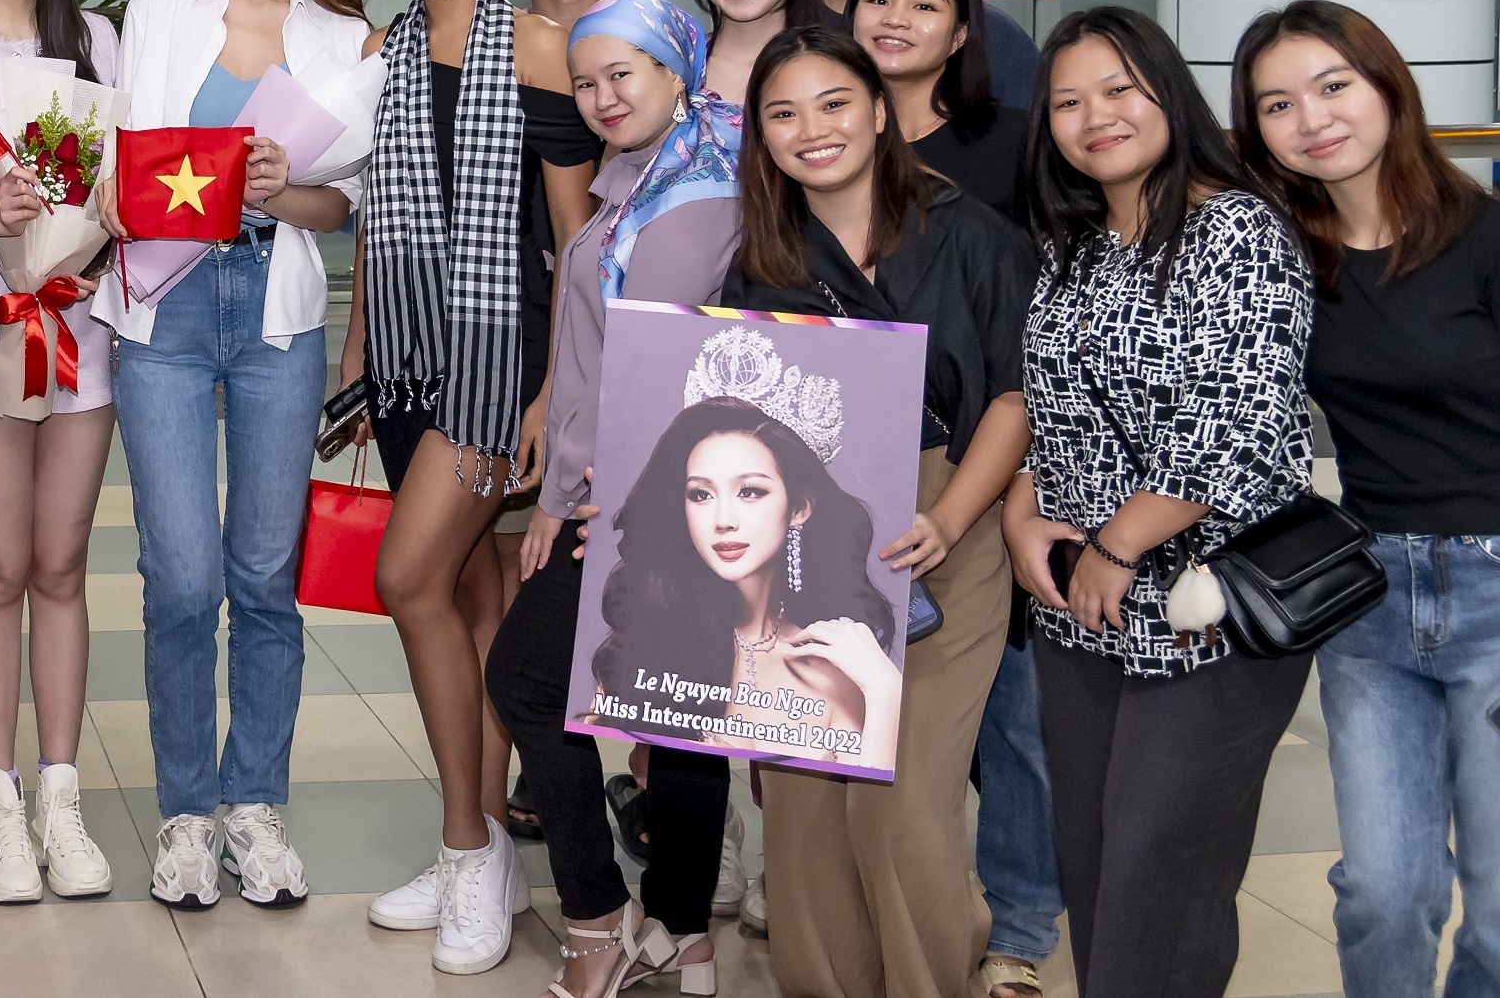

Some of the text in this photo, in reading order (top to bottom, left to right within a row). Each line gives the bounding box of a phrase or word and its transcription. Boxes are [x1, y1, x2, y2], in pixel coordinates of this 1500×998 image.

[633, 668, 826, 720] Le Nguyen Bao Ngoc
[593, 693, 862, 755] Miss Intercontinental 2022
